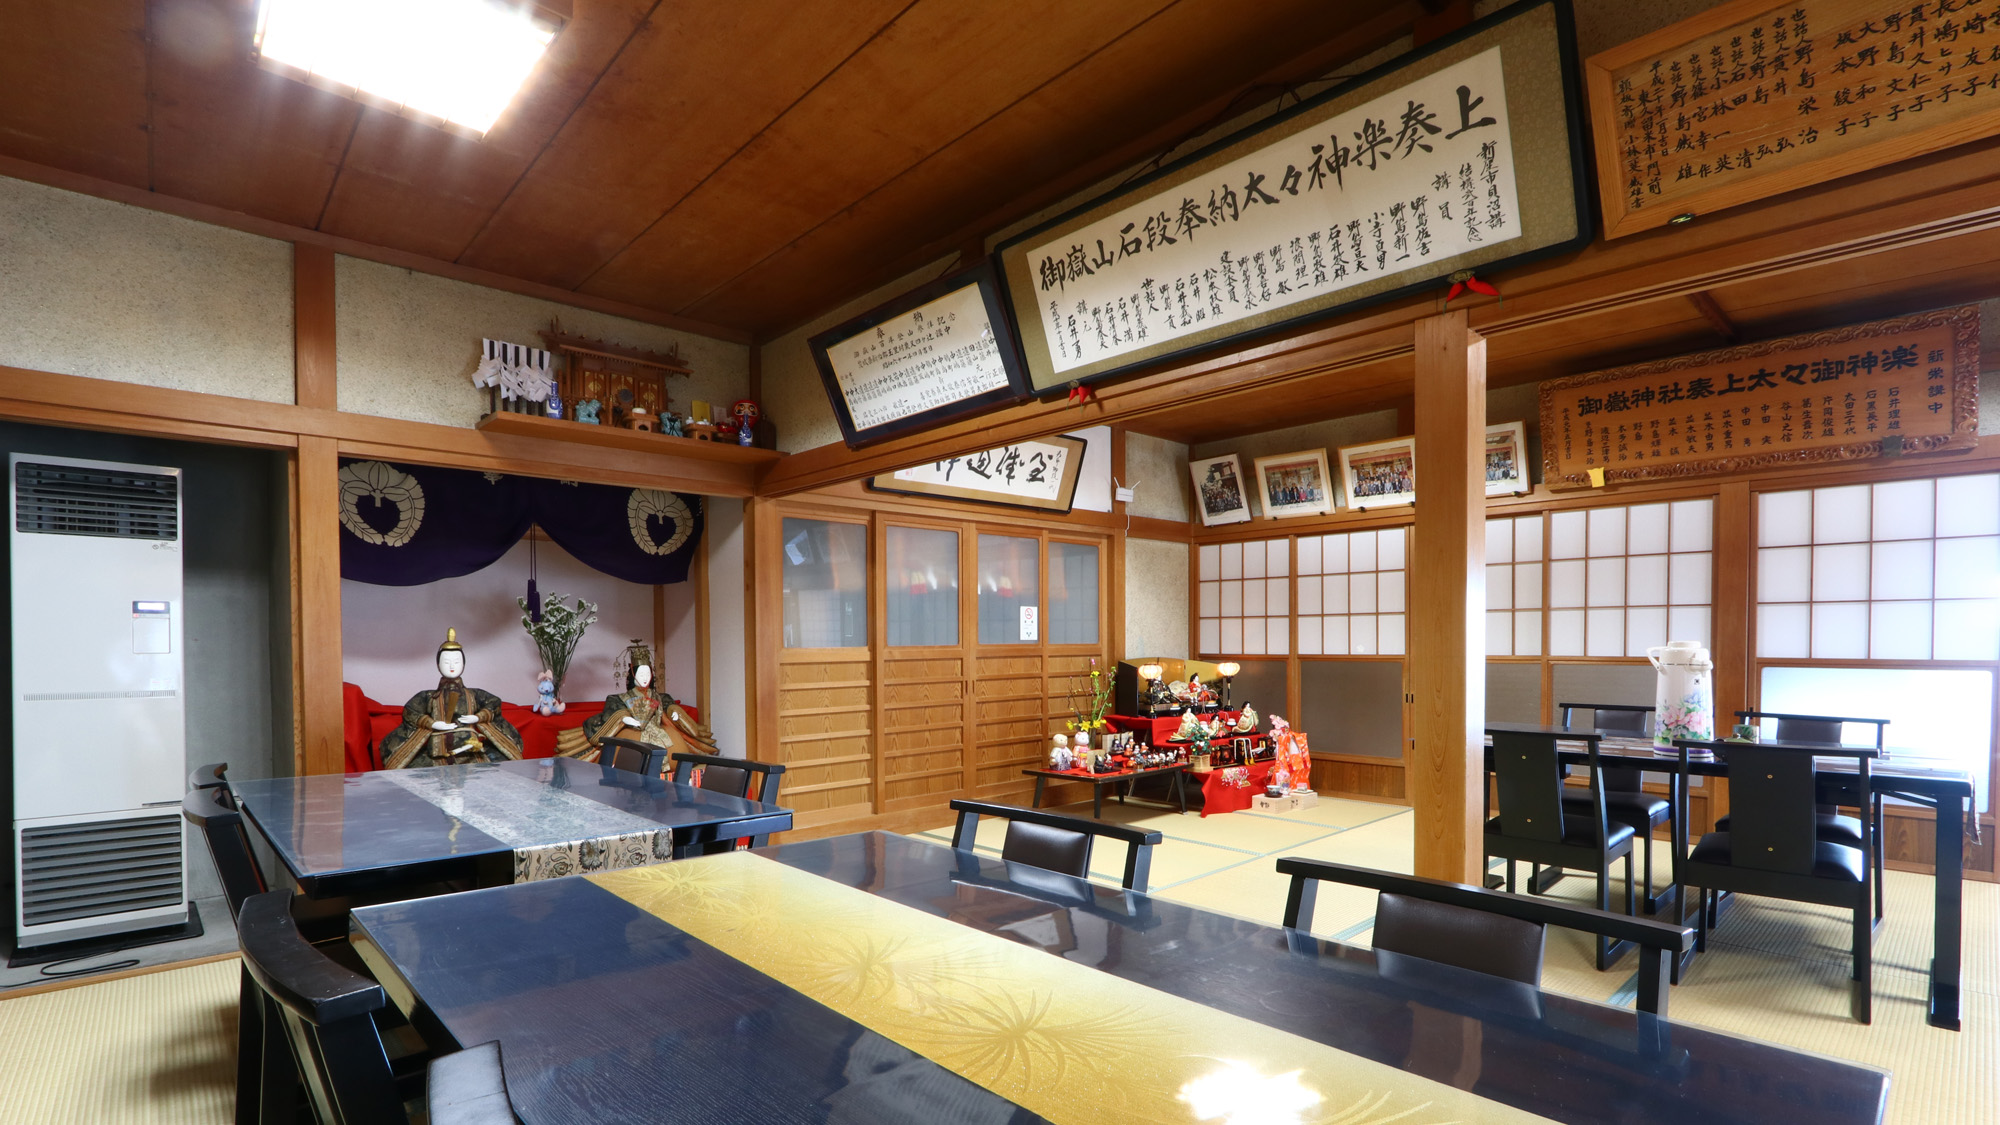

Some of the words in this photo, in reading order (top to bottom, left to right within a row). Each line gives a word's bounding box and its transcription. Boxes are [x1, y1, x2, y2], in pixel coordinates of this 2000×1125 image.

[1577, 343, 1919, 417] 御嶽神社奏上太々御神楽
